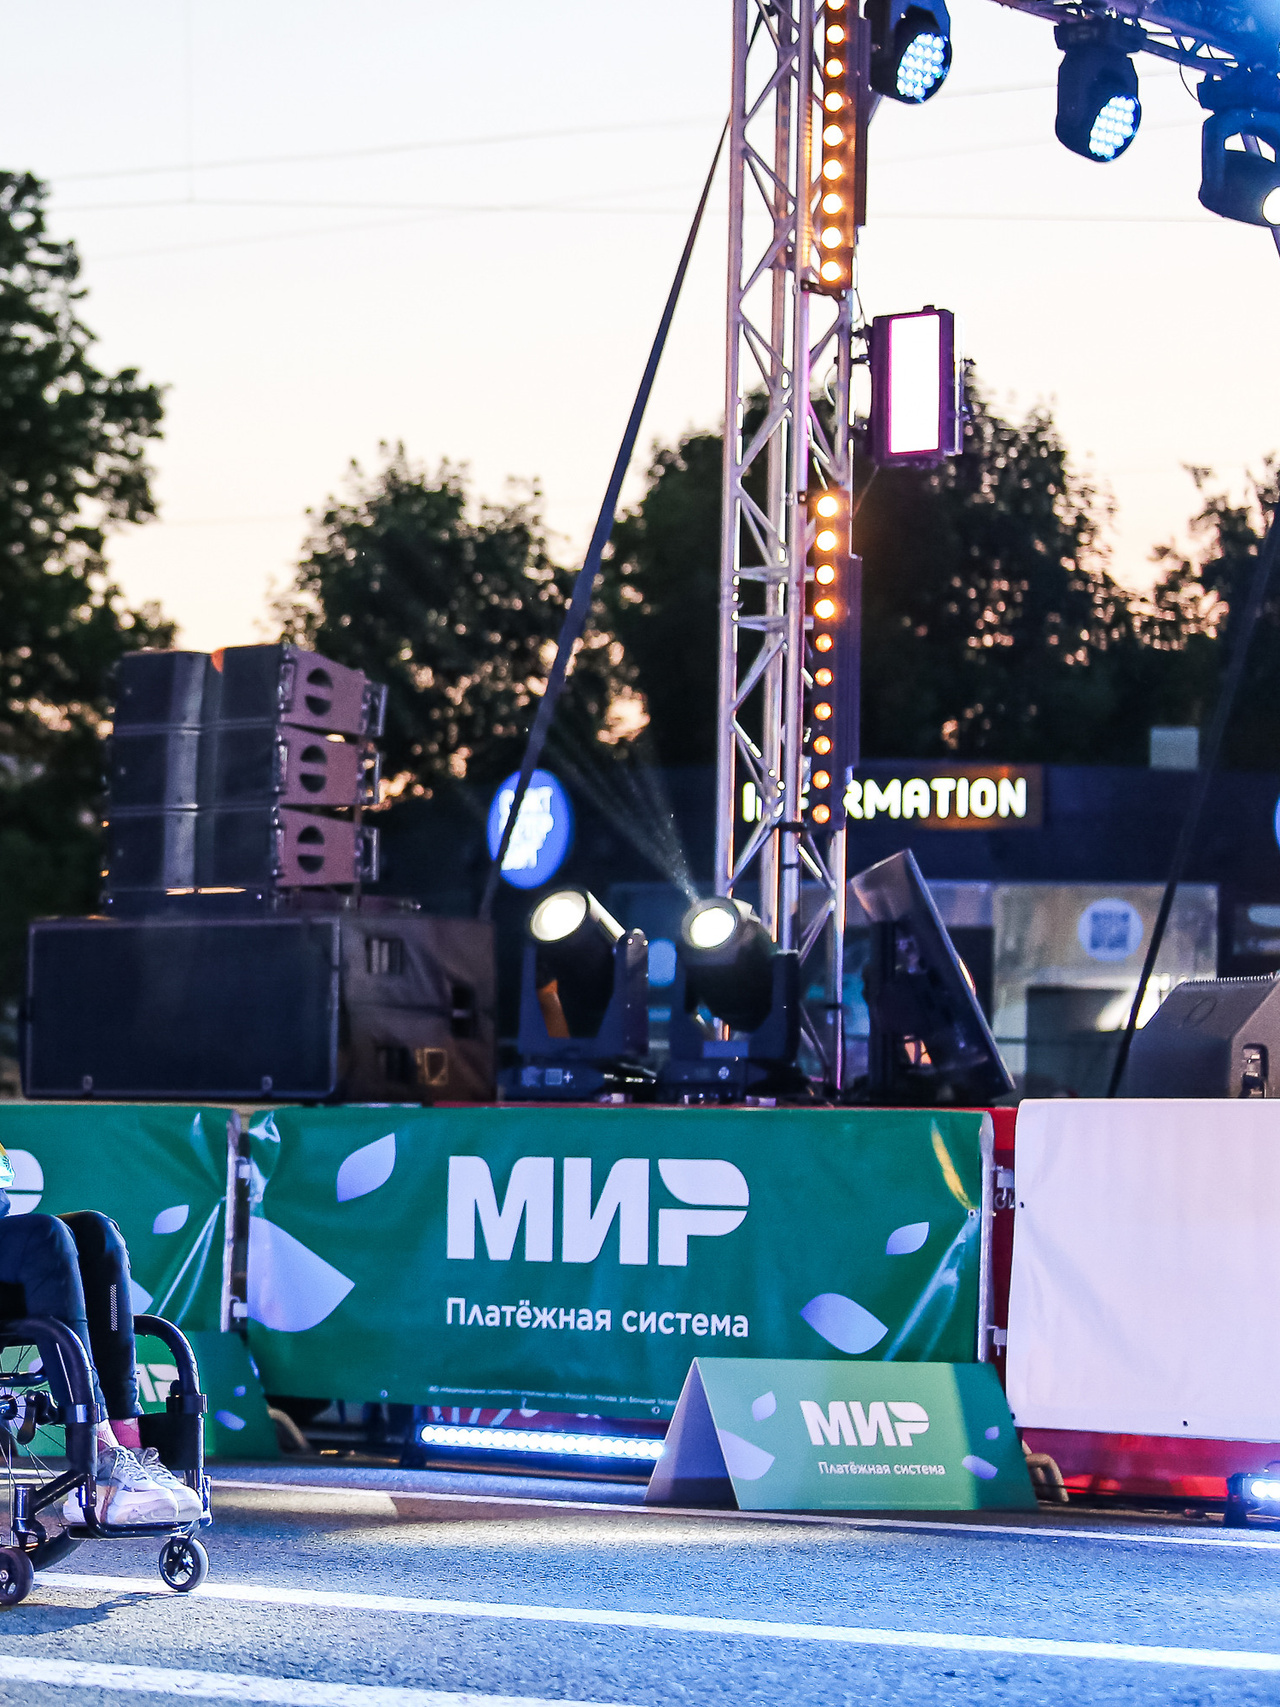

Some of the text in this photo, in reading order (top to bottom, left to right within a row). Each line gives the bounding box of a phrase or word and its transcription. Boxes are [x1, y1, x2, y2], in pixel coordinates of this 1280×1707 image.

[742, 777, 1027, 823] IRMATION
[446, 1155, 750, 1266] МИР
[446, 1297, 749, 1338] Платёжная система
[800, 1400, 930, 1446] МИР
[818, 1461, 946, 1476] Платёжная система
